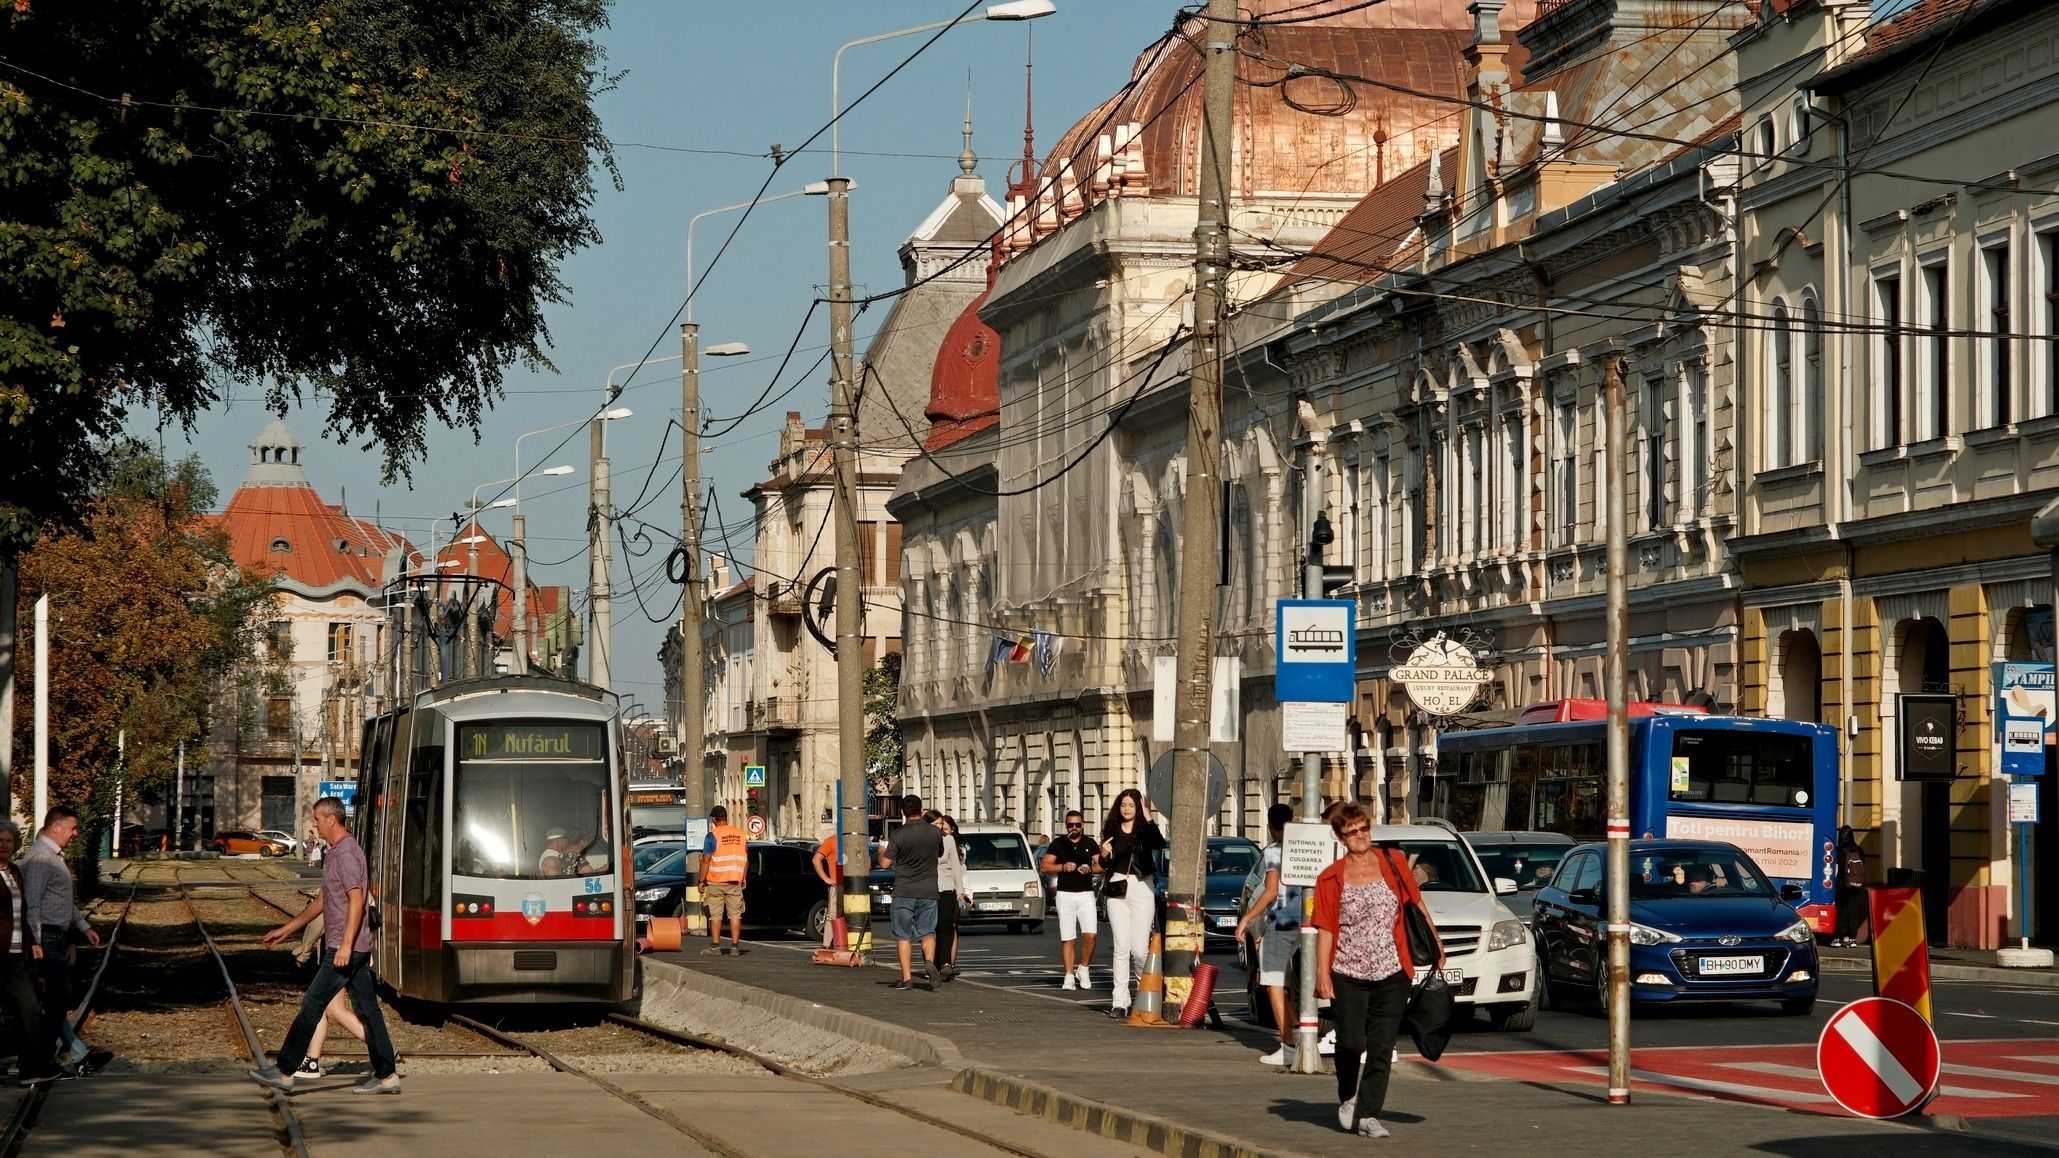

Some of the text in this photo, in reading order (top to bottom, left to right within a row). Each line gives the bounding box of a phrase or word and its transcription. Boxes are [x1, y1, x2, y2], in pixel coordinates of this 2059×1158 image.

[1396, 670, 1489, 680] GRAND PALACE
[1423, 697, 1461, 705] HOEL
[473, 733, 571, 755] 1N Nufărul
[1915, 736, 1943, 744] VIVO KEBAB
[1704, 824, 1759, 838] pentru
[1763, 825, 1810, 841] Bihor!
[1762, 857, 1777, 865] mai
[1778, 858, 1798, 866] 2022
[585, 878, 602, 893] 56
